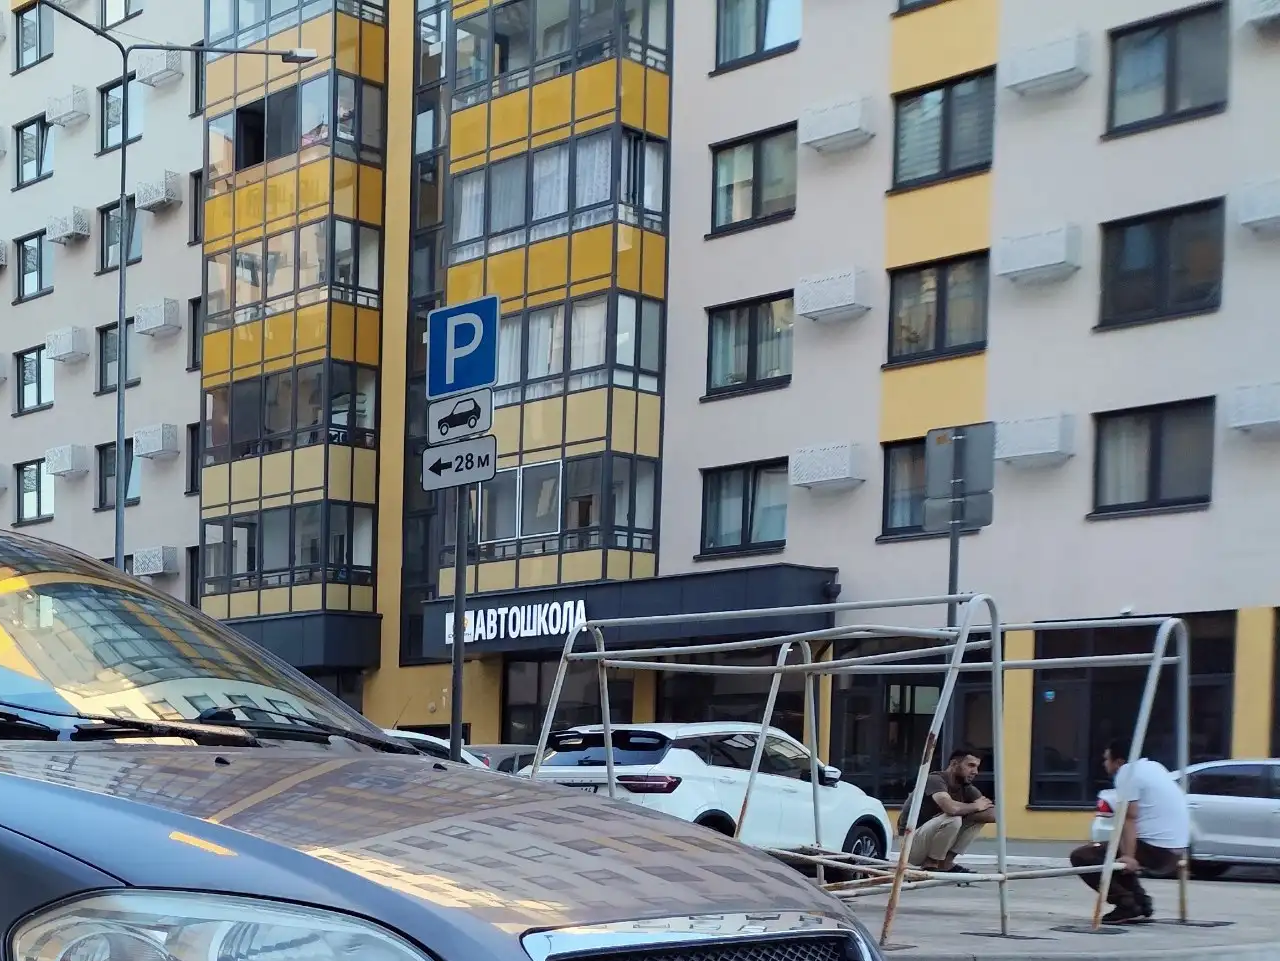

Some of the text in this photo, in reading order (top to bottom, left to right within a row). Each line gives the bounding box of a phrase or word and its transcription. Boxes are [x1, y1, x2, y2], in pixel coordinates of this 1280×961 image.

[445, 312, 484, 385] P
[454, 453, 474, 473] 28
[474, 599, 588, 641] АВТОШКОЛА
